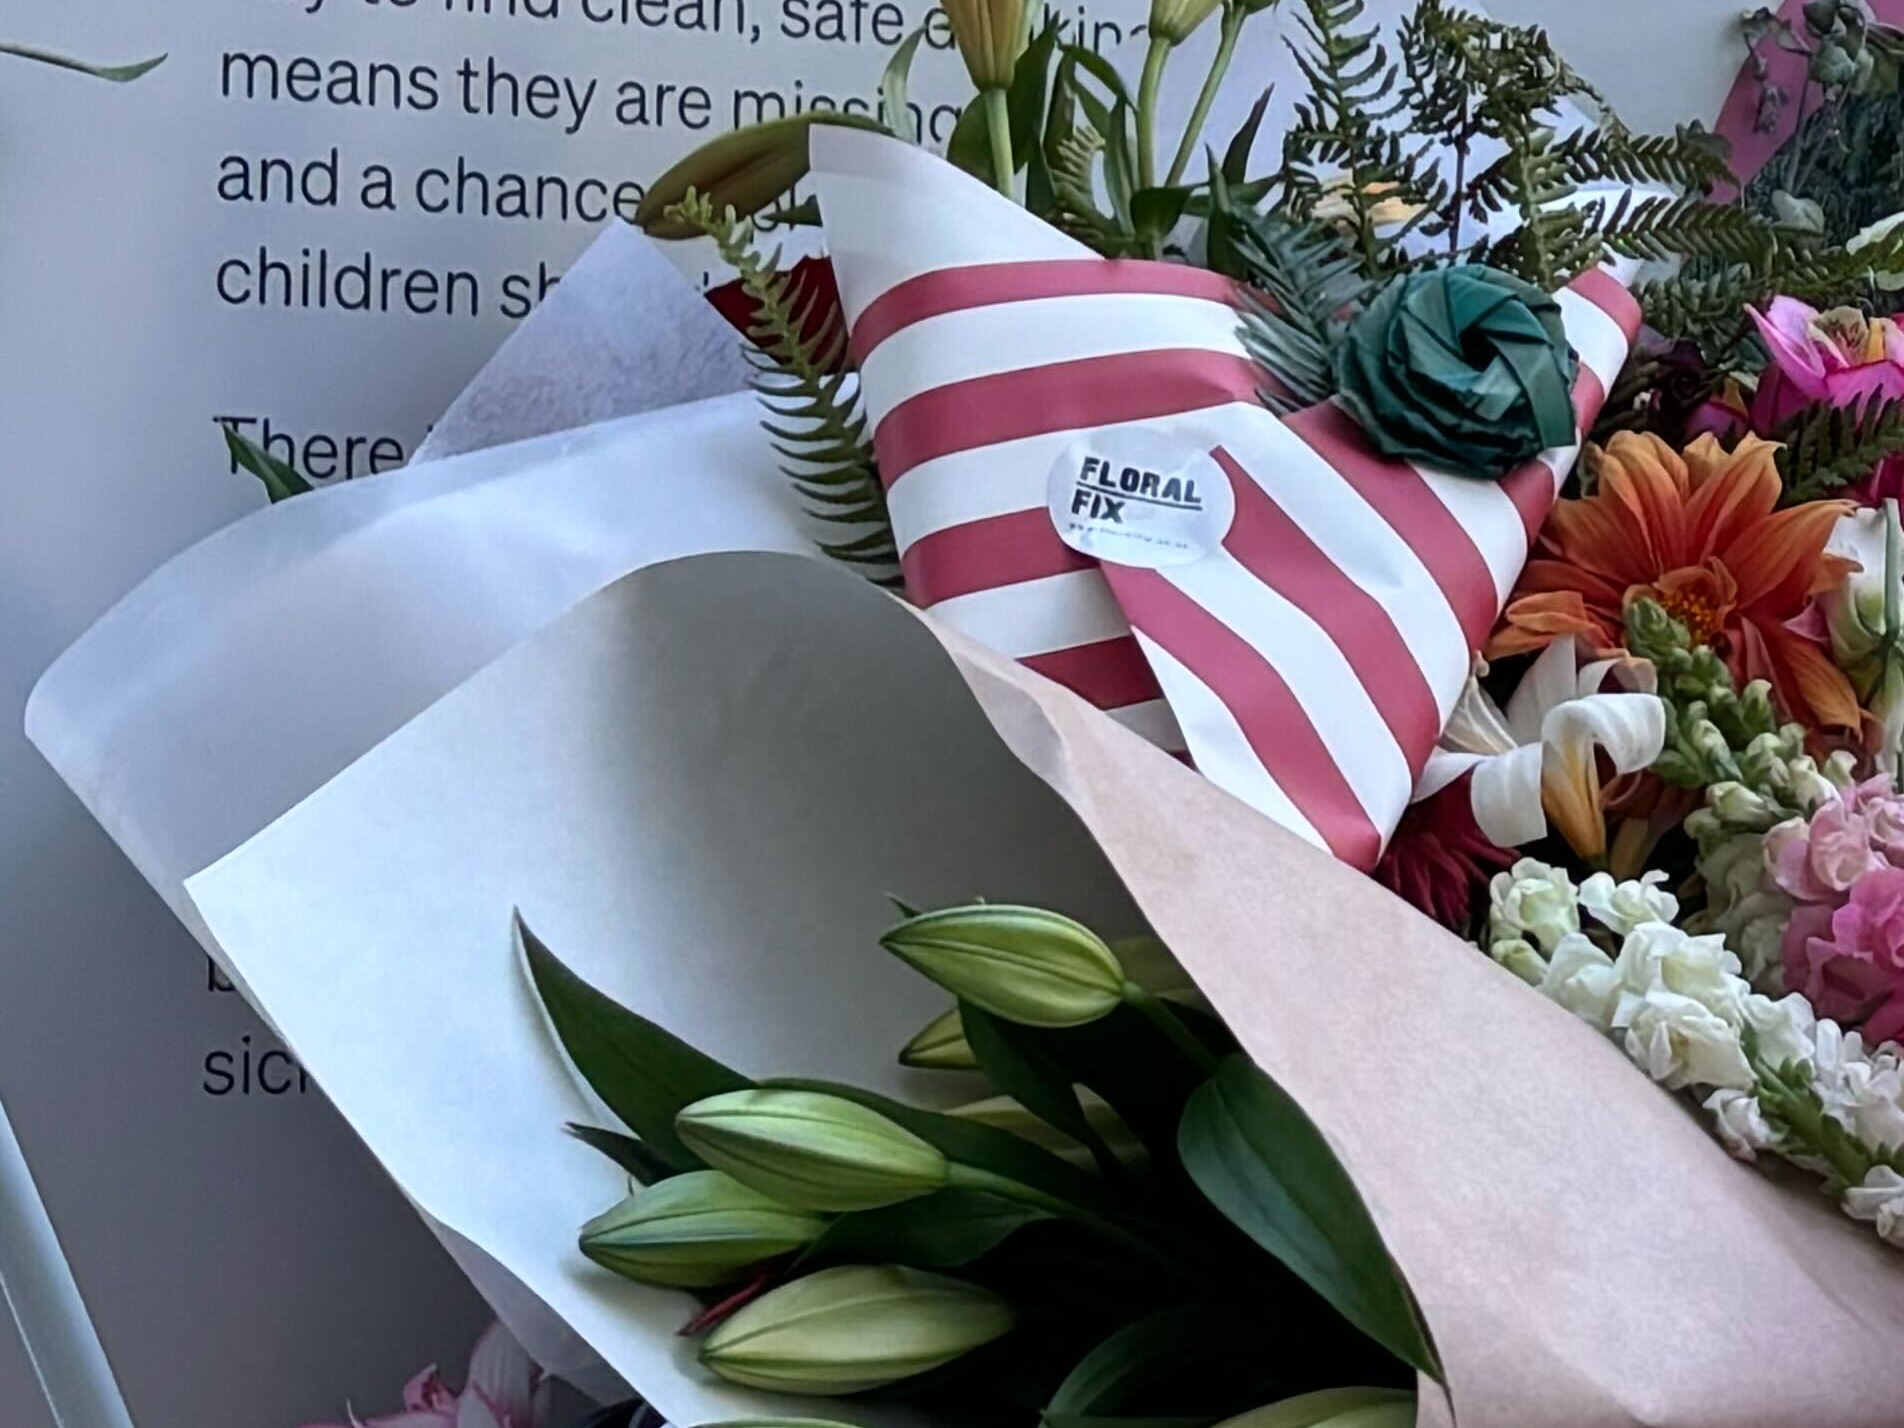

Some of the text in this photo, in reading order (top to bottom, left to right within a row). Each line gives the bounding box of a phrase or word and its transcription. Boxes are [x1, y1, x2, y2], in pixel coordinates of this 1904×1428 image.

[222, 52, 439, 111] means
[456, 56, 597, 135] they
[615, 81, 712, 130] are
[217, 147, 645, 224] and a chance
[216, 245, 479, 318] children
[1070, 487, 1126, 524] FIX
[1079, 455, 1202, 504] FLORAL
[203, 1035, 306, 1095] sic
